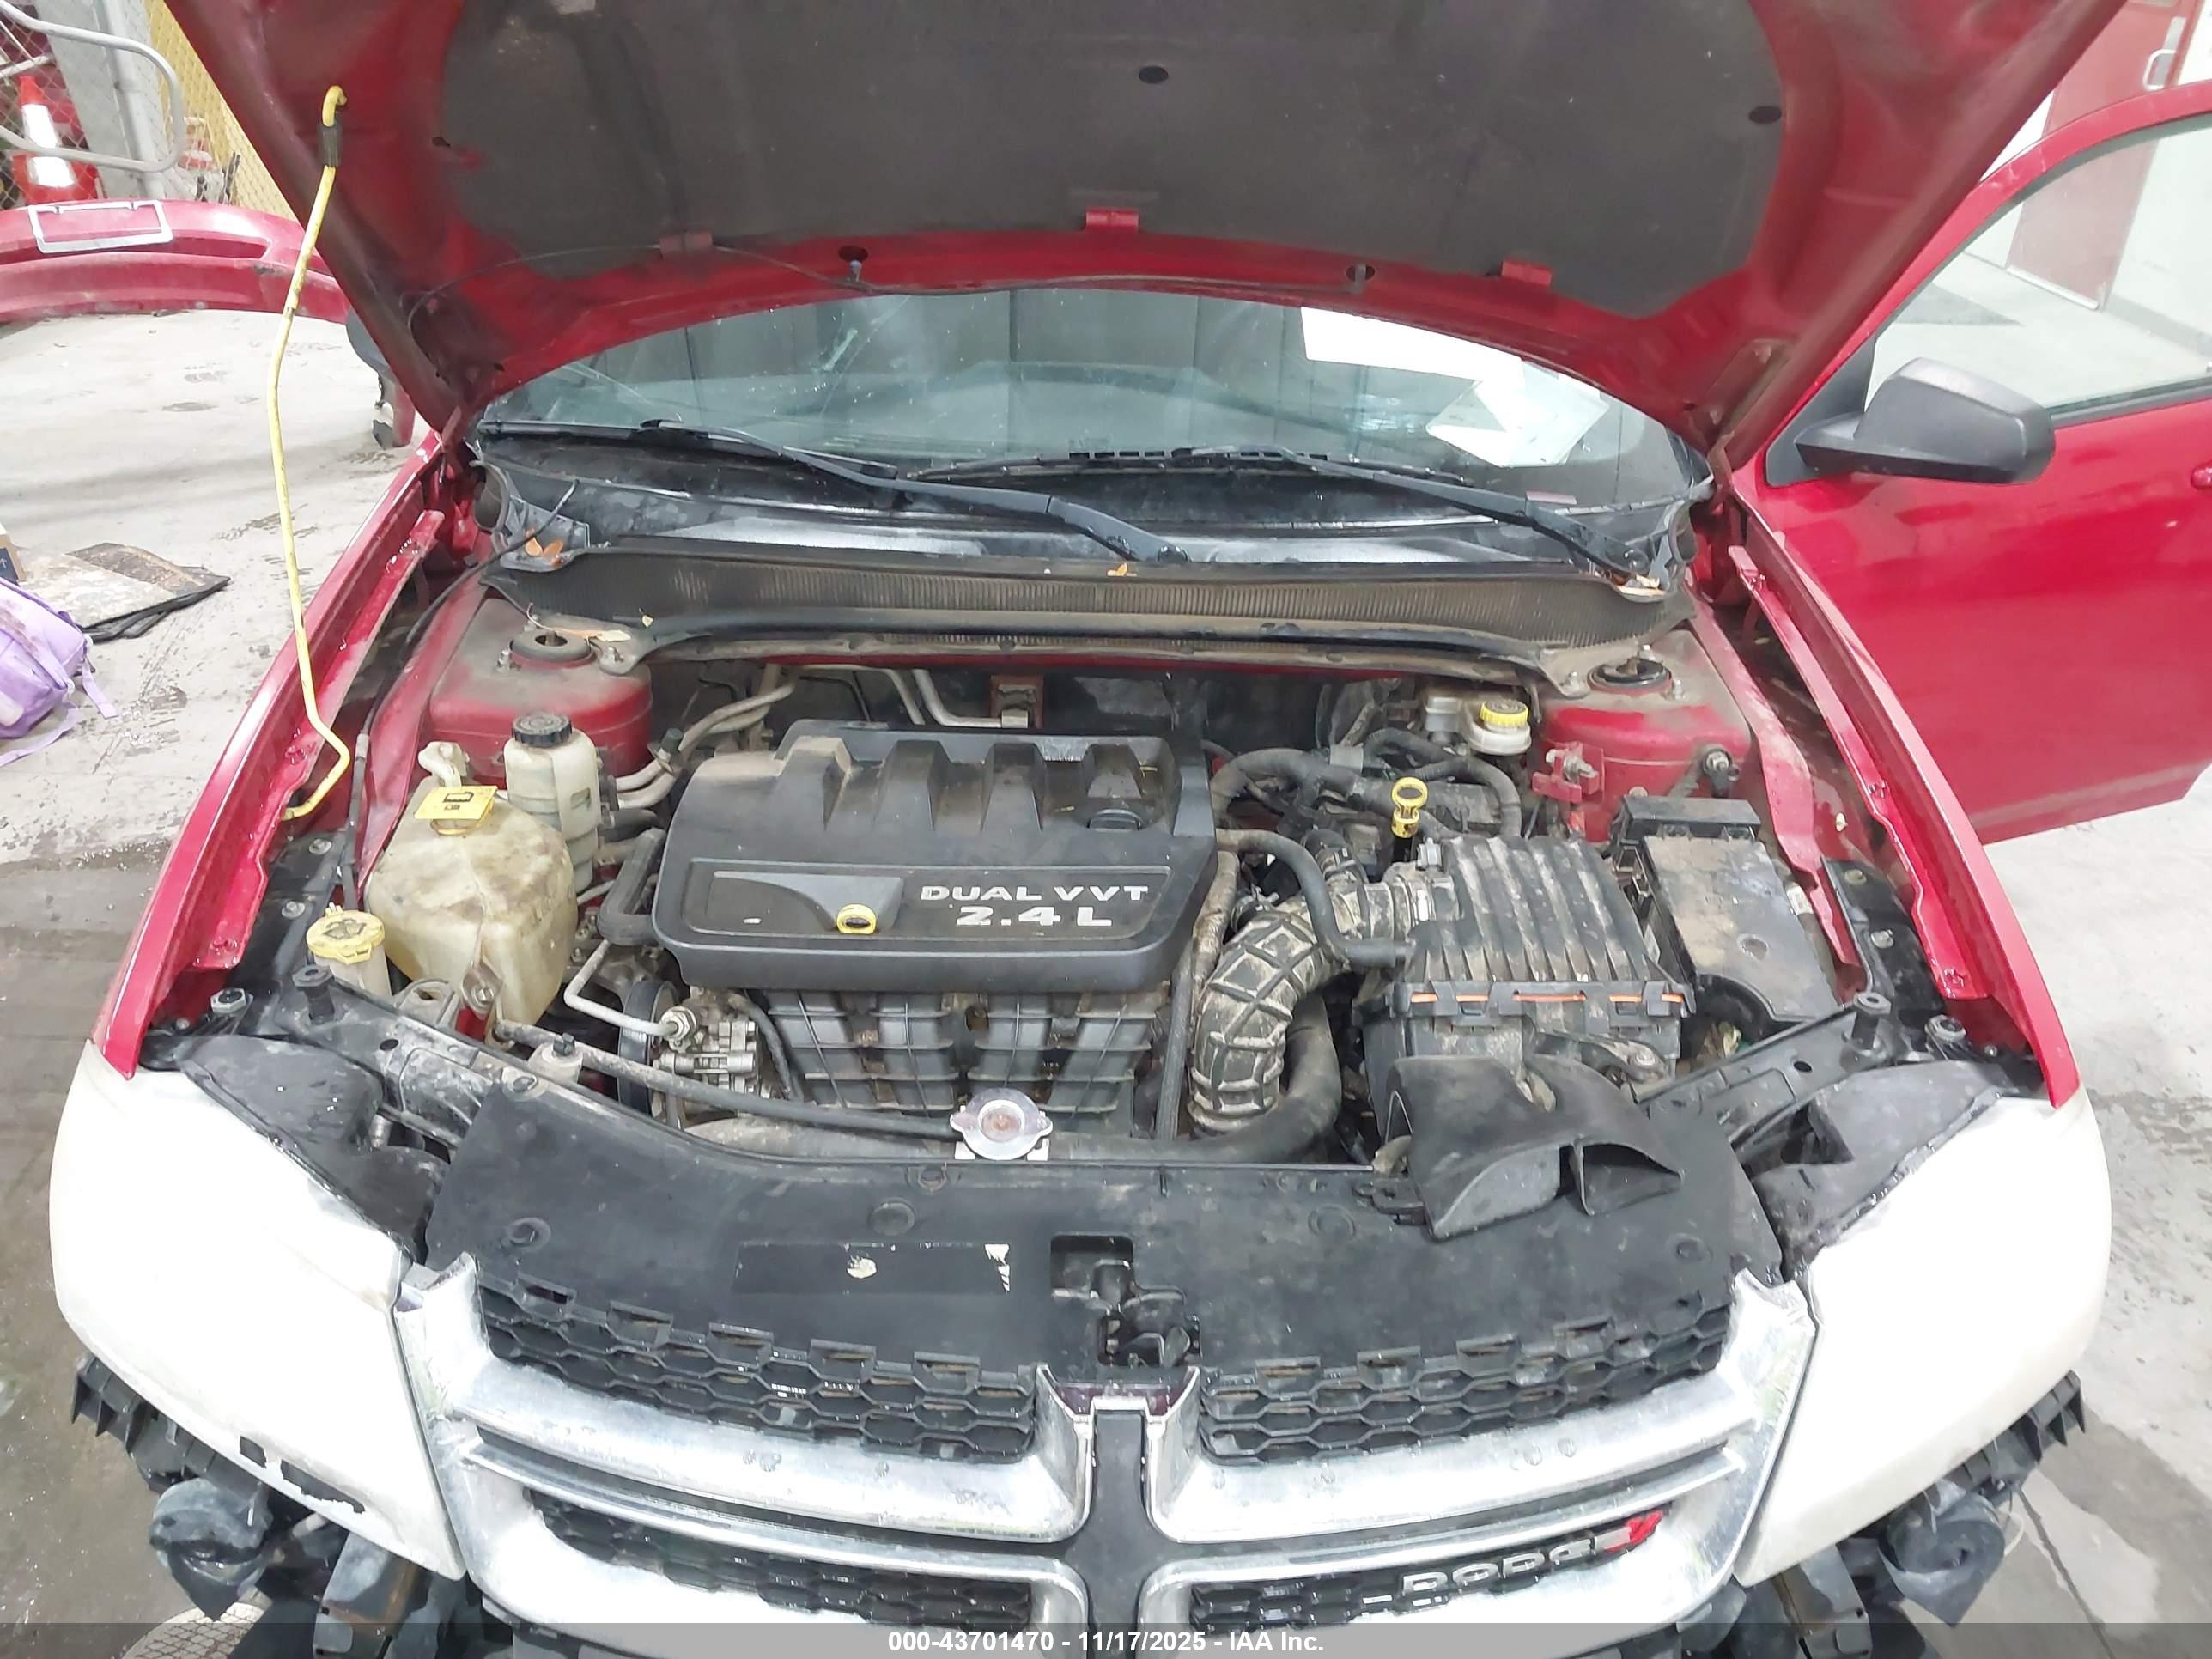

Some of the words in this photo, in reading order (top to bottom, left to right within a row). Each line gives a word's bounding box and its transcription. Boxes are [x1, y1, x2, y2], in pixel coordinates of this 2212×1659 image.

[921, 885, 1042, 902] DUAL
[1054, 885, 1149, 902] VVT
[957, 906, 1062, 927] 2.4
[1077, 906, 1113, 927] L
